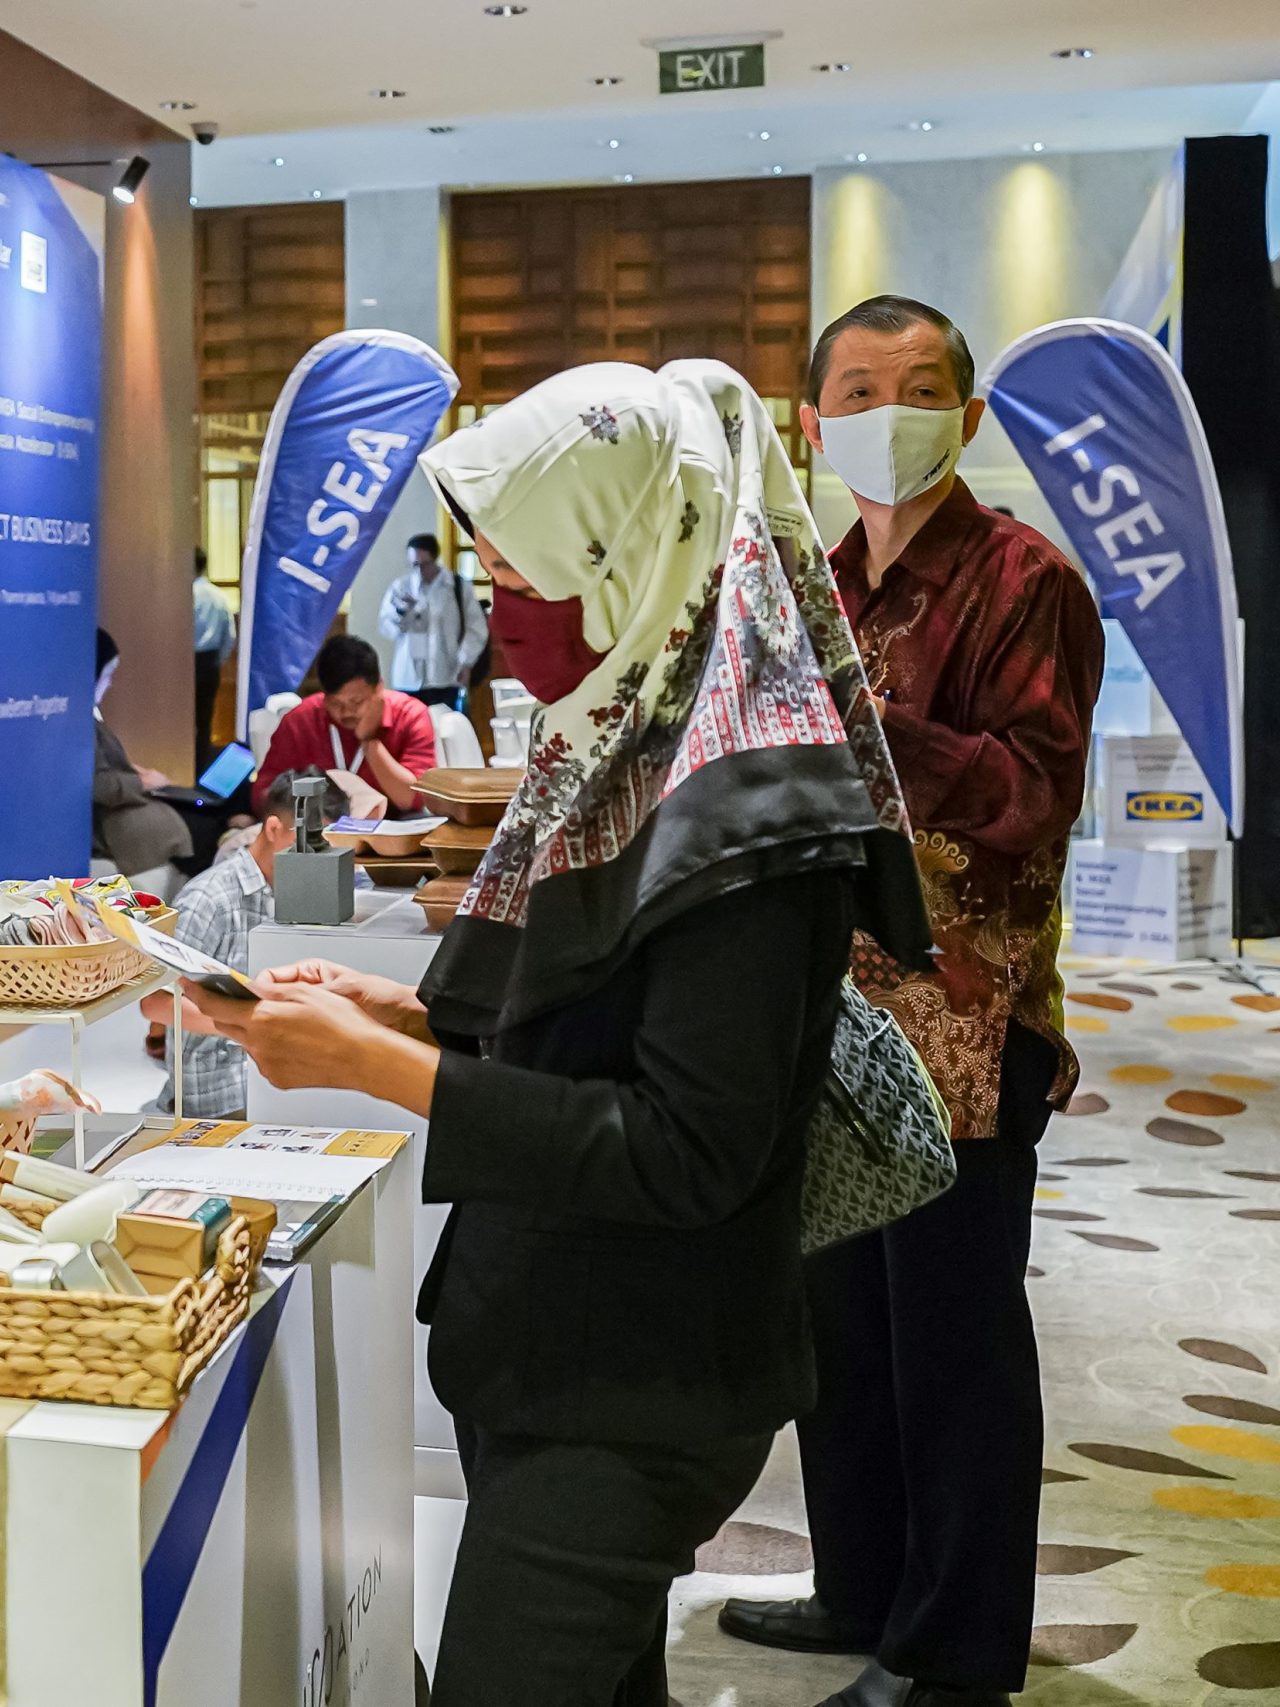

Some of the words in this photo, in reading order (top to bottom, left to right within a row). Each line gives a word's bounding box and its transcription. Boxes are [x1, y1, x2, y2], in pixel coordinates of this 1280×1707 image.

[676, 51, 745, 89] EXIT
[278, 428, 410, 594] I-SEA
[1043, 413, 1186, 612] I-SEA
